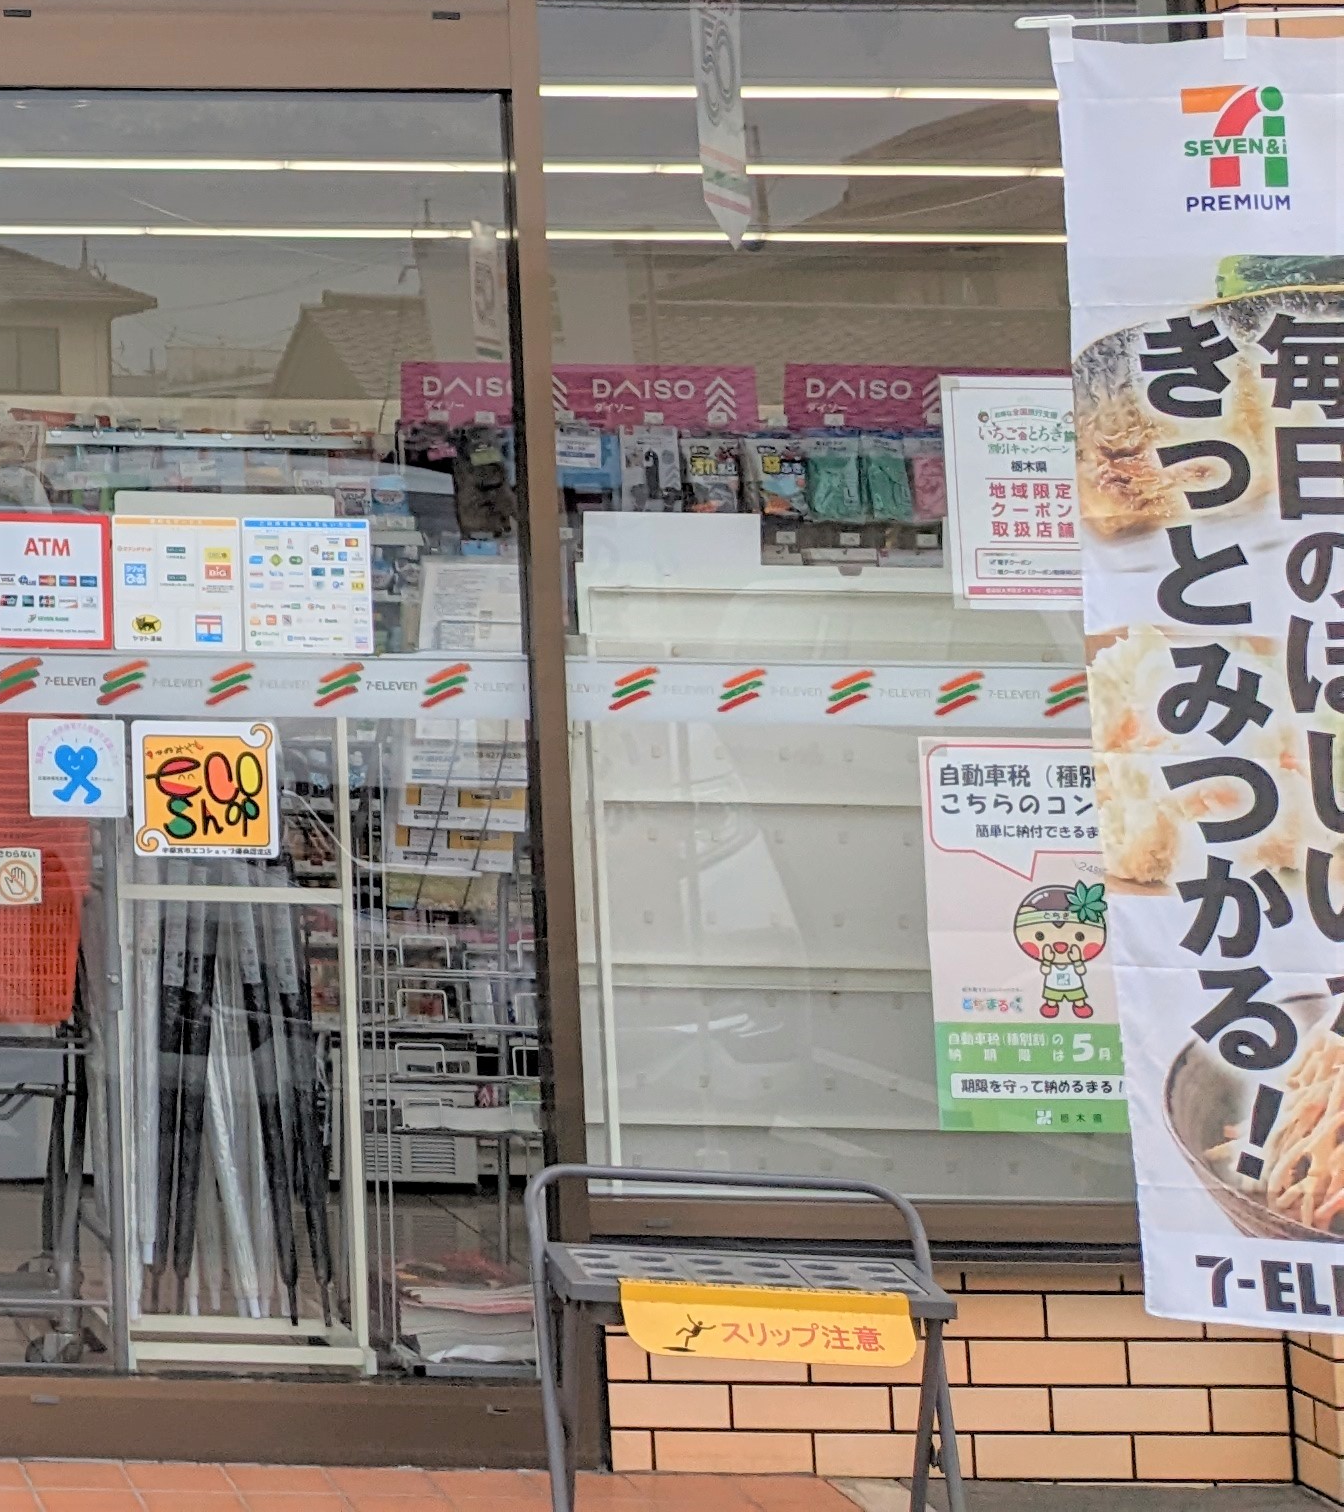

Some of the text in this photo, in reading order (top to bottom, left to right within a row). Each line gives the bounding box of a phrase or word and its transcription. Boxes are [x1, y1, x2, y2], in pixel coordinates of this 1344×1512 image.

[1185, 193, 1292, 213] PREMIUM
[421, 375, 512, 398] DAIS
[591, 378, 696, 400] DAISO
[805, 377, 913, 401] DAISO
[988, 482, 1073, 500] 地域限定
[990, 502, 1073, 519] クーポン
[991, 521, 1075, 539] 取扱店舗
[23, 537, 71, 557] ATM
[720, 1320, 886, 1353] スリップ注意
